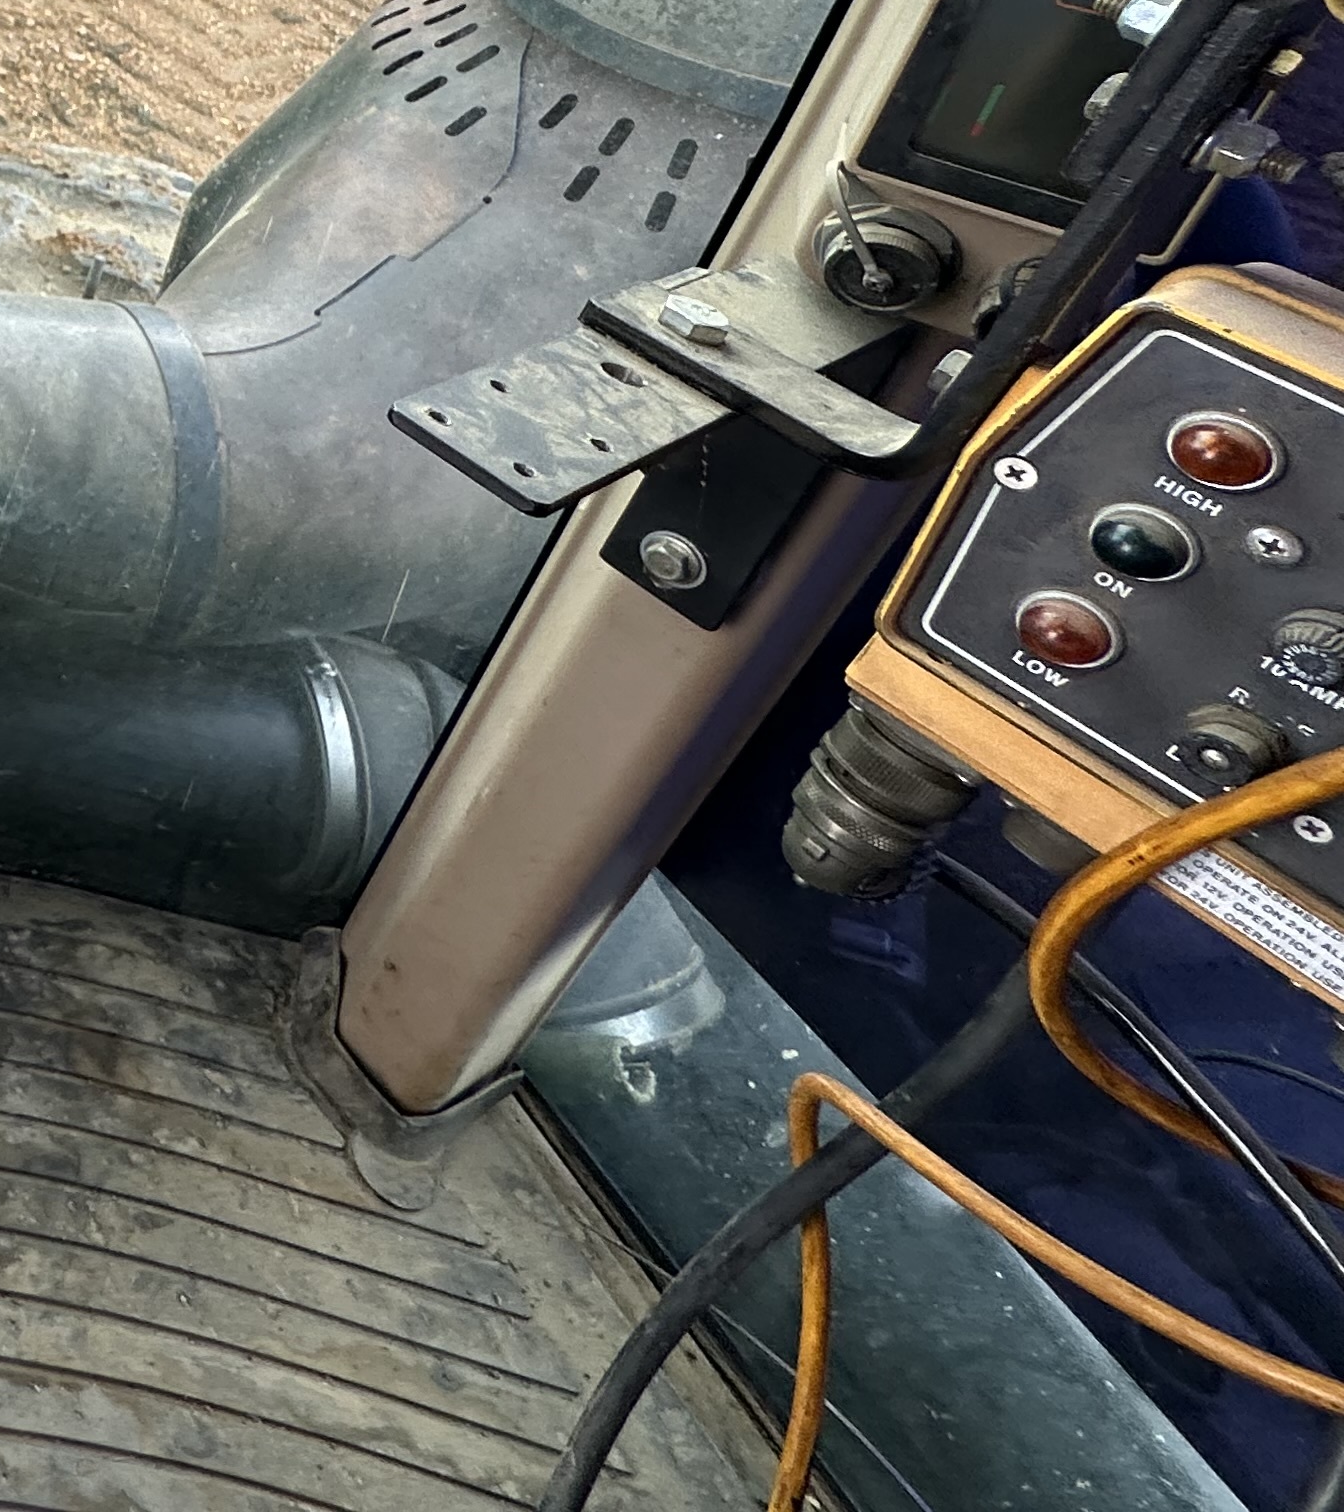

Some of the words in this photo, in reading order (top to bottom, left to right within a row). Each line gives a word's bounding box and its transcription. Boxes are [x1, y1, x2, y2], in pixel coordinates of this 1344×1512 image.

[1154, 476, 1223, 517] HIGH
[1094, 572, 1134, 598] ON
[1012, 650, 1070, 687] LOW
[1174, 861, 1197, 881] OR
[1232, 902, 1317, 959] OPERATION
[1190, 859, 1259, 904] OPERATE
[1261, 904, 1285, 921] ON
[1251, 883, 1344, 942] ASSEMBLED
[1223, 913, 1308, 969] OPERATION
